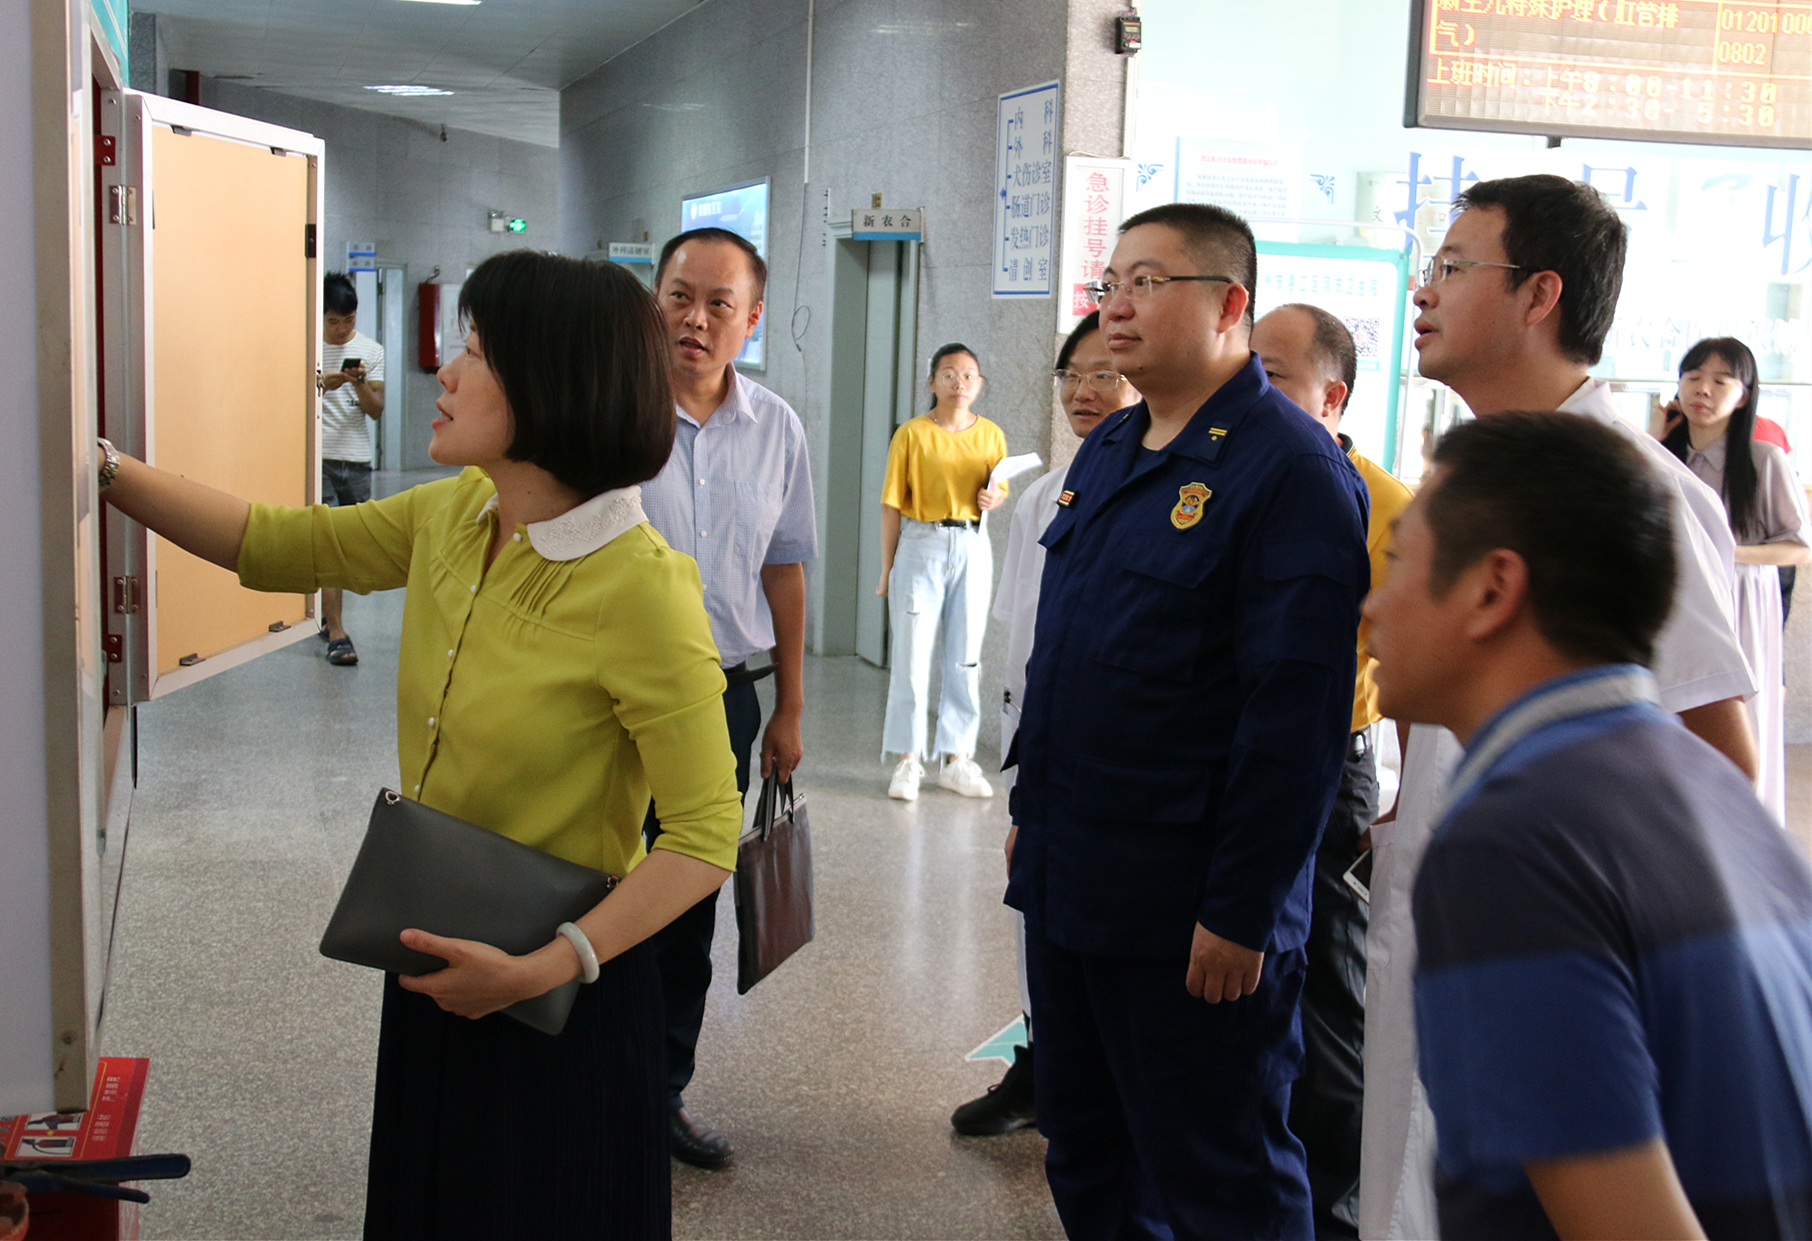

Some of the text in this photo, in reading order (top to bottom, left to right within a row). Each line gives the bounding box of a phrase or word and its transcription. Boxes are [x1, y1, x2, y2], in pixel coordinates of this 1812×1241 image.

[1718, 41, 1766, 66] 0802
[1011, 159, 1052, 188] 犬伤诊室
[1010, 192, 1050, 218] 肠道门诊
[863, 213, 912, 229] 新农合
[1010, 223, 1049, 250] 发热门诊
[1008, 256, 1048, 282] 清创室
